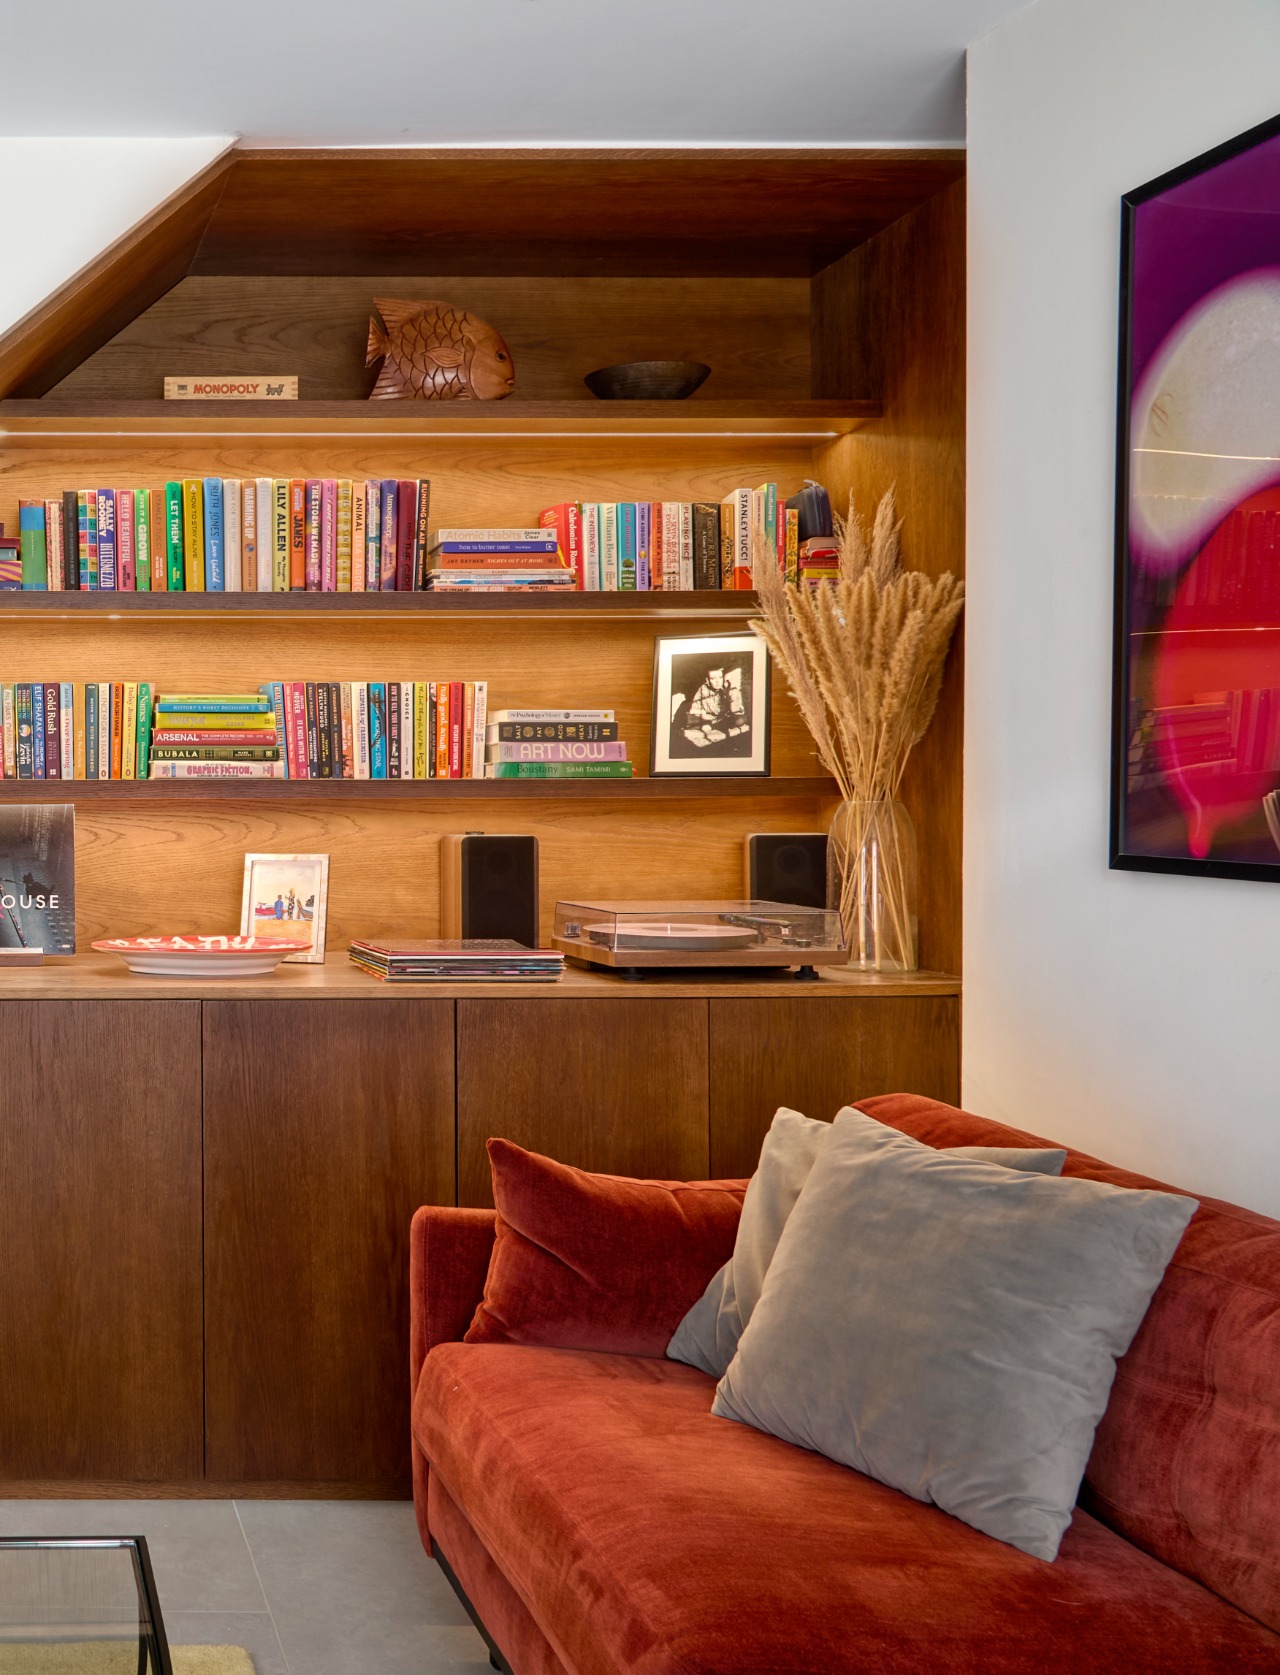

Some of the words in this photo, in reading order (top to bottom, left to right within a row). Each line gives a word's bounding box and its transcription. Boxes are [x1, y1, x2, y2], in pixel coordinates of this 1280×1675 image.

[193, 384, 260, 394] MONOPOLY
[210, 485, 220, 508] RUTH
[277, 485, 286, 509] LILY
[311, 485, 319, 499] THE
[99, 496, 107, 537] ROONEY
[106, 500, 114, 531] SALLY
[121, 494, 130, 519] HELLO
[171, 501, 179, 516] LET
[192, 511, 198, 520] TO
[245, 487, 255, 526] WARMING
[311, 501, 319, 527] STORM
[384, 493, 394, 539] Atmosphere
[657, 509, 662, 519] NO
[172, 518, 180, 544] THEM
[209, 511, 220, 537] JONES
[245, 528, 255, 539] UP
[277, 513, 286, 552] ALLEN
[293, 515, 303, 549] JAMES
[311, 528, 319, 541] WE
[420, 519, 427, 531] ON
[445, 531, 485, 541] Atomic
[487, 530, 521, 540] Habits
[568, 507, 577, 549] Caledonian
[606, 506, 615, 542] William
[122, 521, 131, 563] BEAUTIFUL
[138, 524, 148, 561] GROW
[311, 541, 319, 564] MADE
[100, 543, 114, 588] INTERMEZZO
[570, 550, 578, 569] Road
[605, 543, 615, 566] Boyd
[47, 689, 56, 711] Gold
[439, 686, 448, 704] really
[35, 702, 43, 732] SHAFAK
[139, 695, 148, 722] Names
[48, 712, 57, 734] Rush
[156, 733, 199, 741] ARSENAL
[438, 727, 448, 752] actually
[63, 738, 71, 769] Sharing
[299, 755, 305, 763] US
[374, 752, 382, 770] STAR
[520, 743, 556, 759] ART
[559, 743, 605, 759] NOW
[187, 765, 219, 775] GRAPHIC
[517, 764, 558, 774] Boustany
